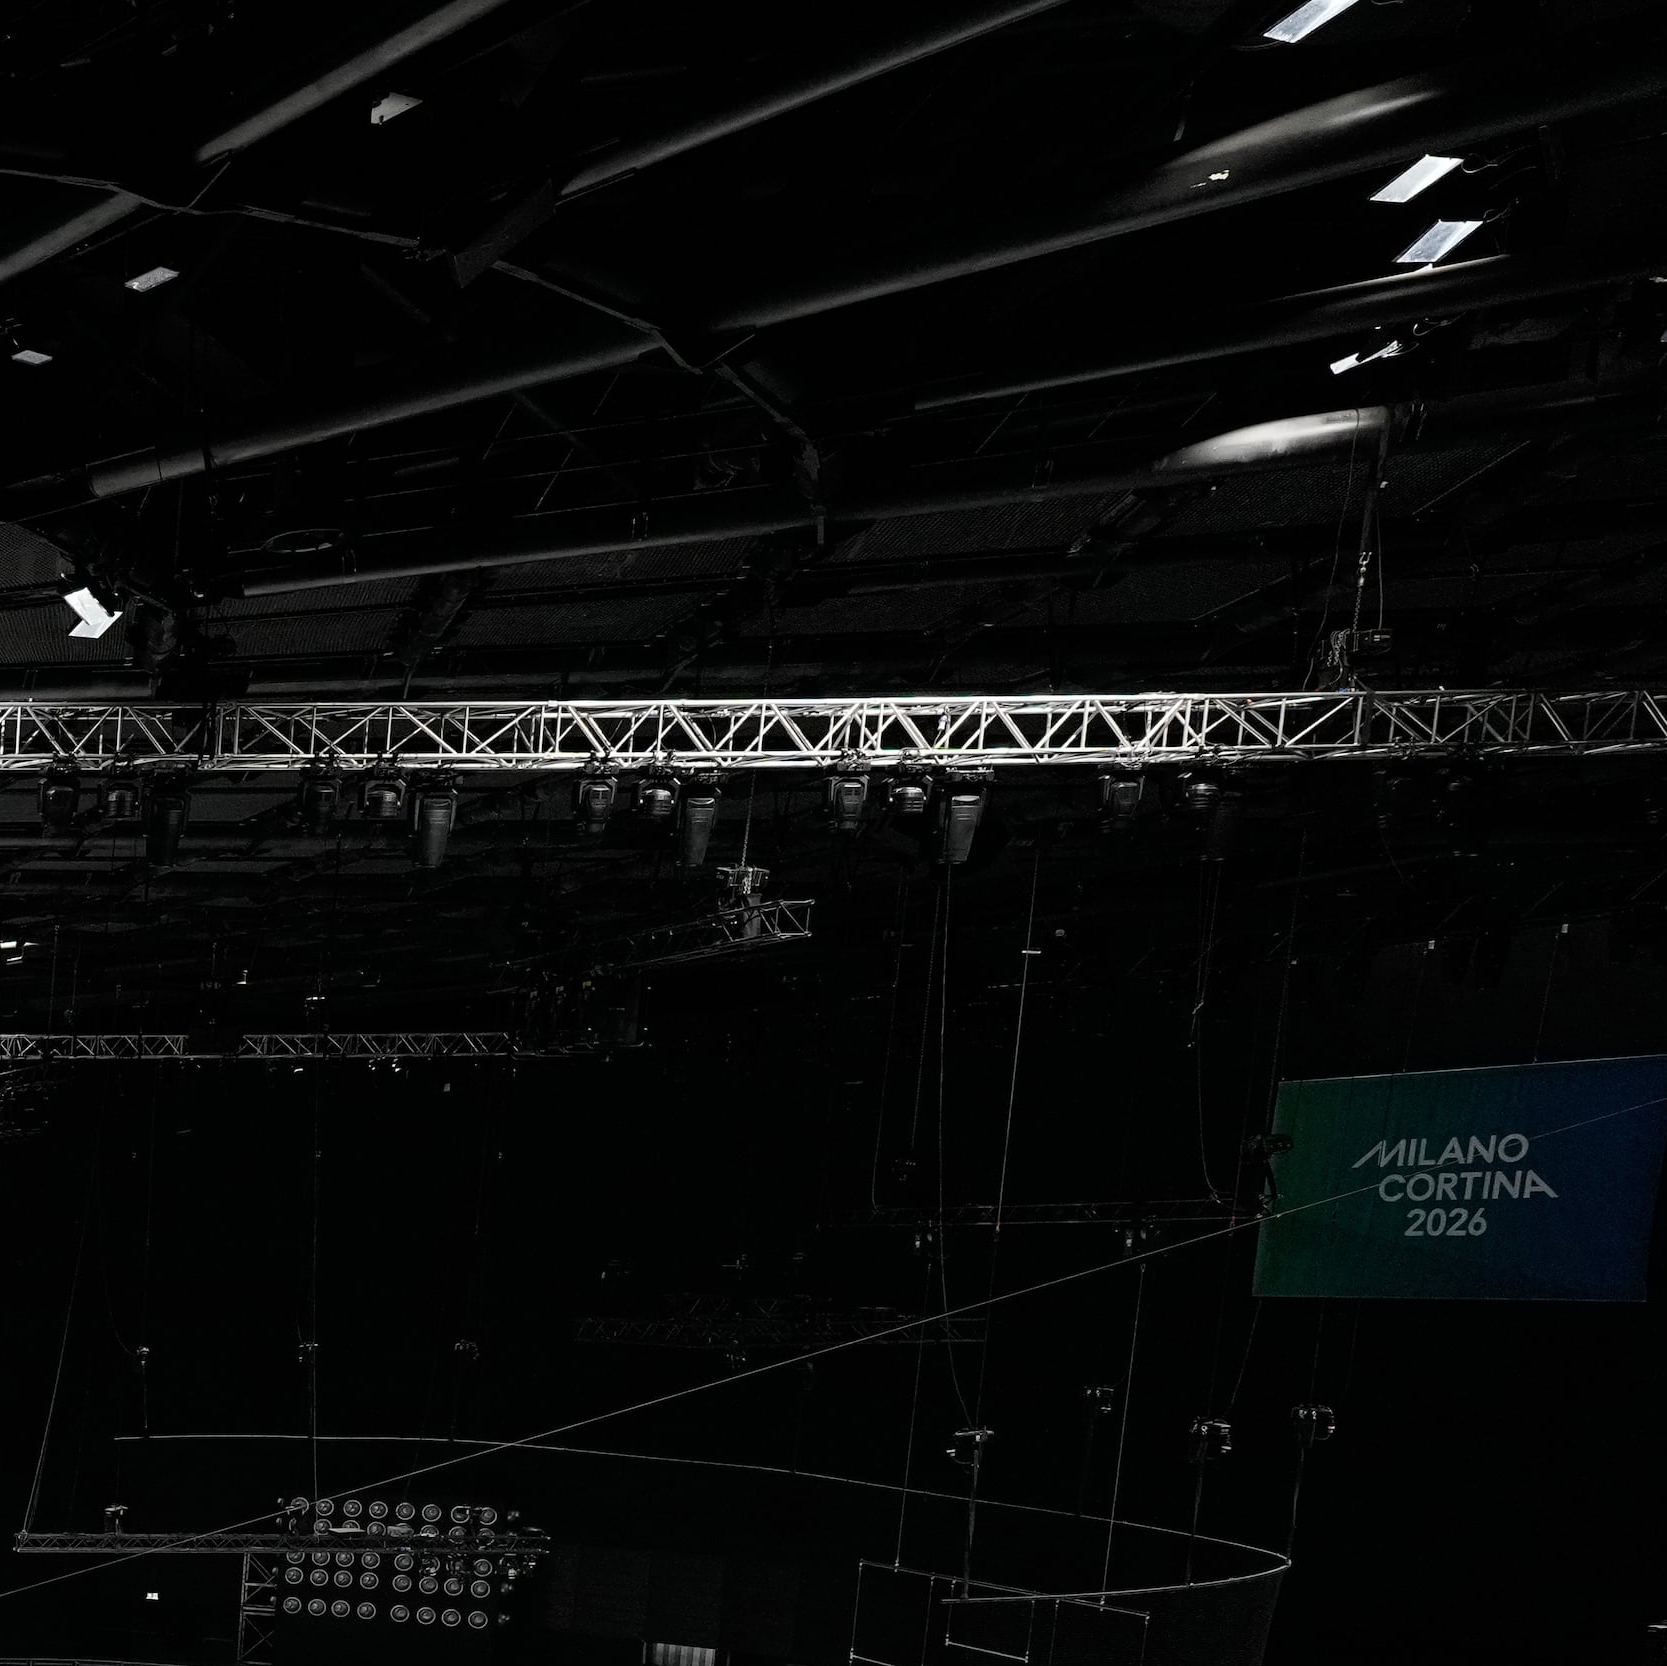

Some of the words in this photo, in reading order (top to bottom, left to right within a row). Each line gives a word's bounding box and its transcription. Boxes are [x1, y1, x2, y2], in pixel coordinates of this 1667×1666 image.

[1351, 1133, 1529, 1169] MILANO
[1378, 1169, 1560, 1202] CORTINA
[1403, 1208, 1487, 1237] 2026
